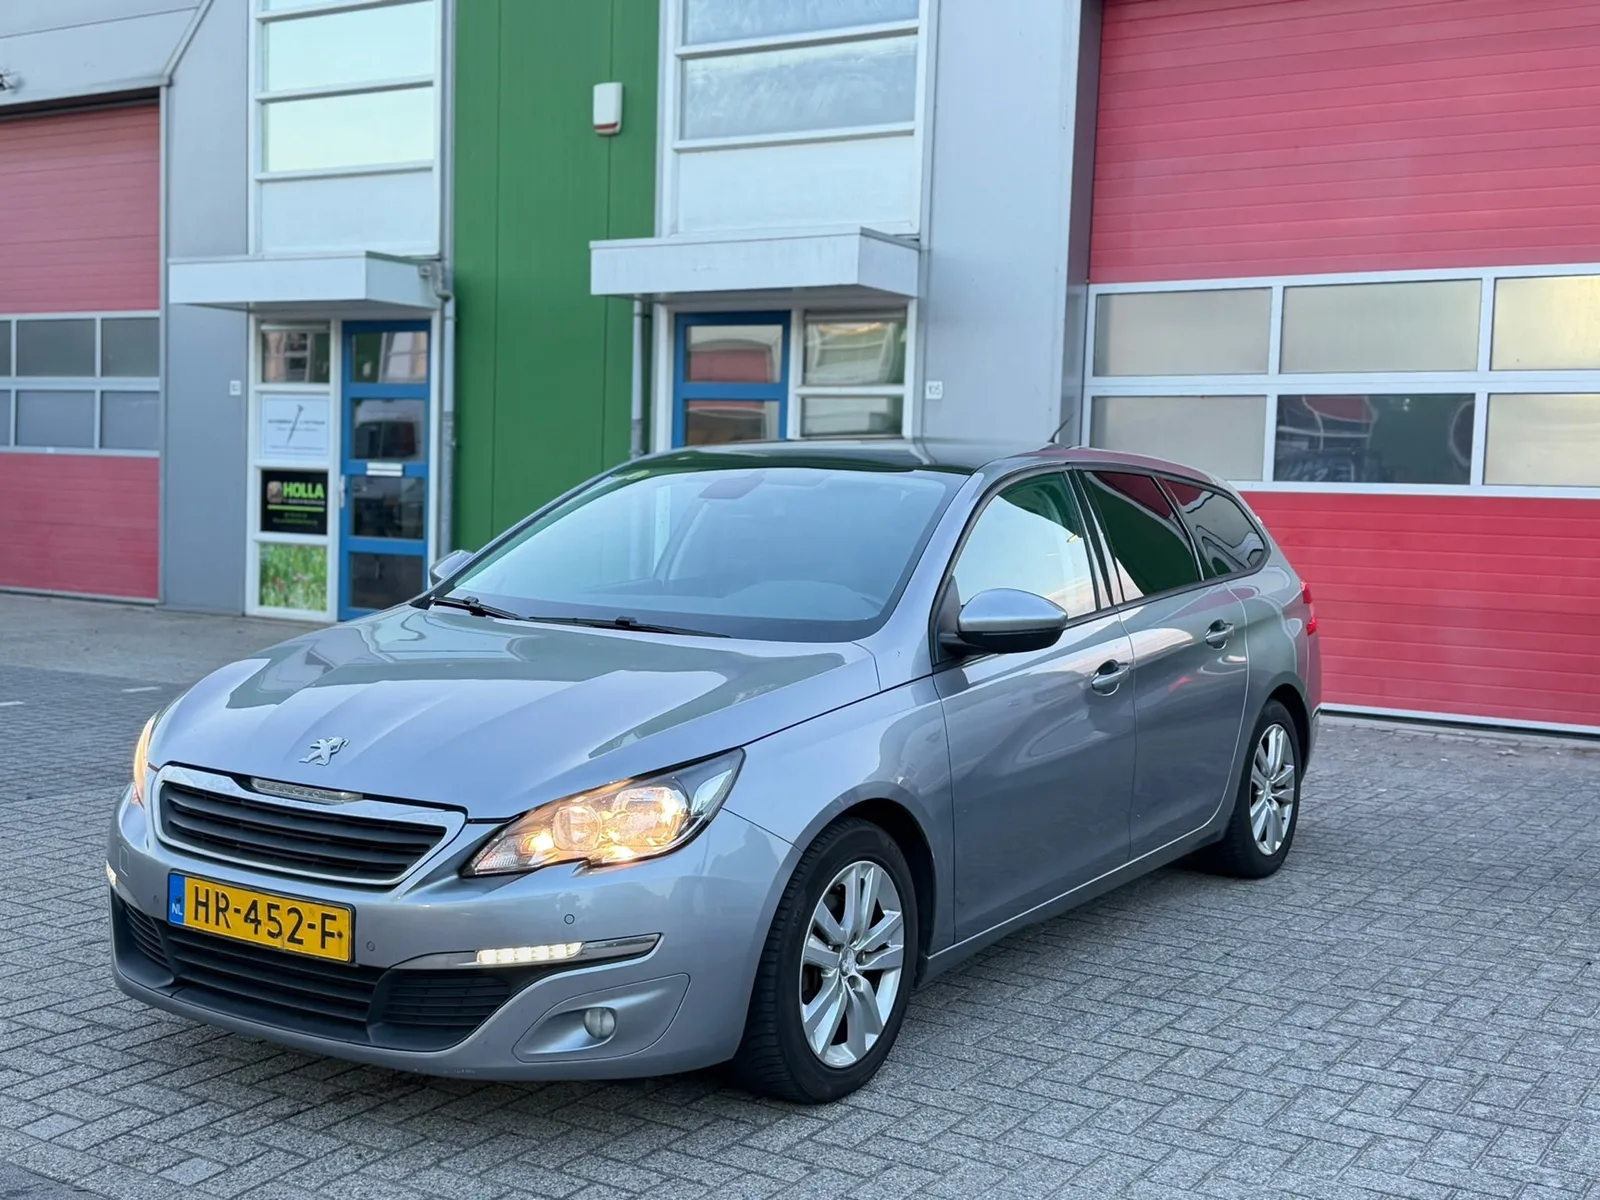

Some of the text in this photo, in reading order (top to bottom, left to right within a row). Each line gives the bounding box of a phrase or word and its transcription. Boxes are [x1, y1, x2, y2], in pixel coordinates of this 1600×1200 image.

[283, 482, 325, 499] HOLLA
[171, 903, 183, 916] NL
[194, 885, 337, 949] HR-452-F
